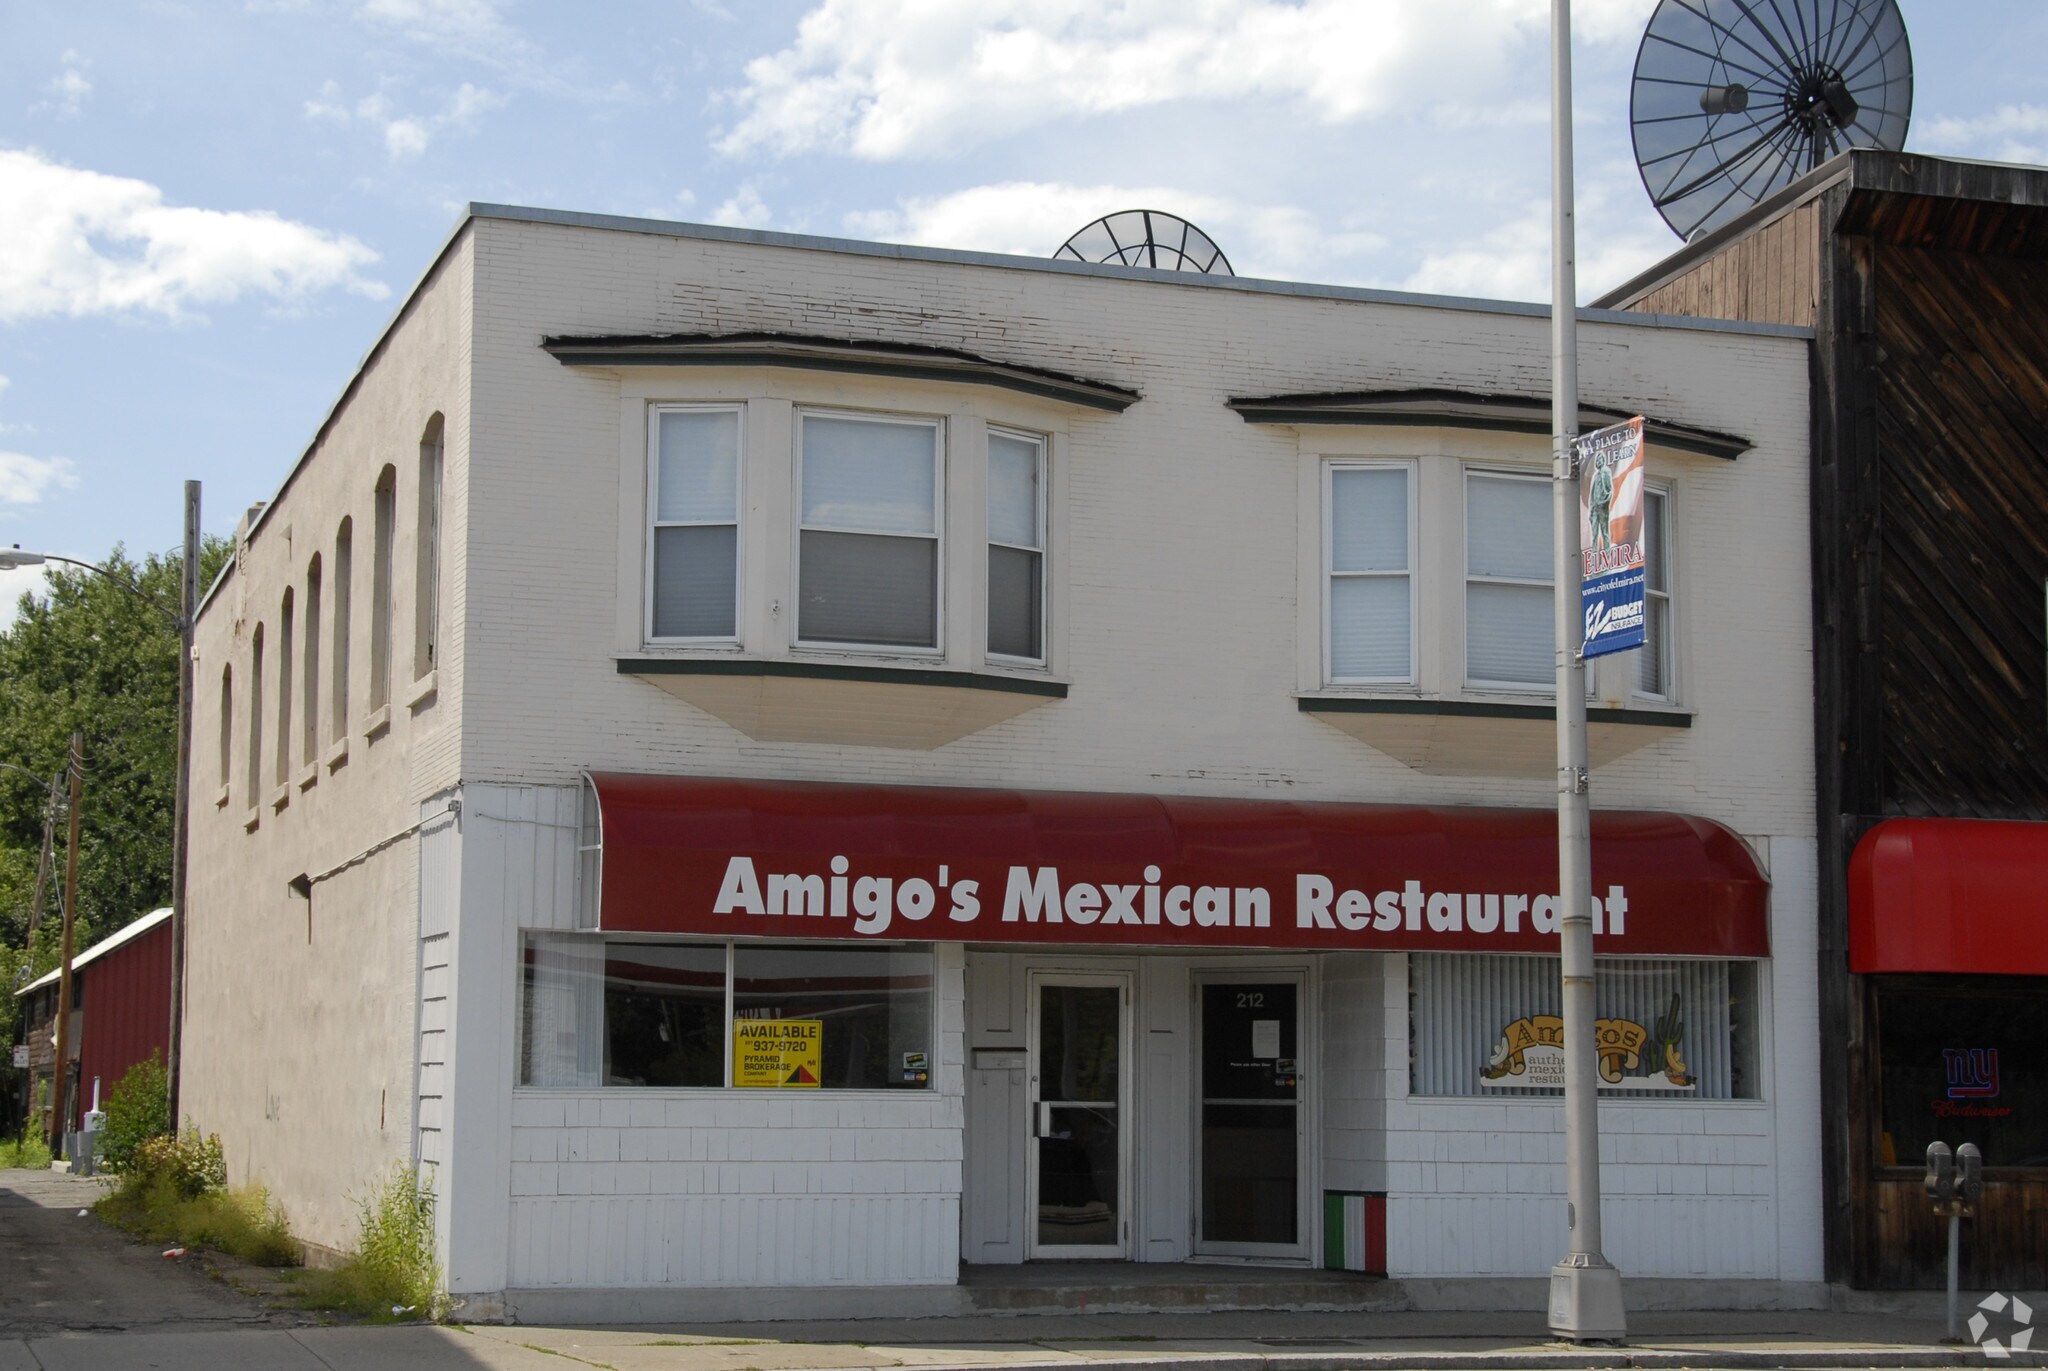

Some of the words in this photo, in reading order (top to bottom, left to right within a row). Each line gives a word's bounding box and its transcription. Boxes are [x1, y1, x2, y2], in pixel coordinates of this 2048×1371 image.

[1595, 431, 1622, 450] PLACE
[1623, 427, 1636, 441] TO
[1607, 444, 1637, 465] LEARN
[1583, 543, 1644, 577] ELMIRA
[1611, 600, 1643, 620] BUDGET
[1610, 616, 1642, 630] INSURANCE
[712, 855, 981, 935] Amigo's
[1001, 864, 1271, 927] Mexican
[1237, 993, 1264, 1007] 212
[740, 1025, 817, 1038] AVAILABLE
[1515, 1021, 1640, 1049] Amo's
[753, 1040, 807, 1052] 937-9720
[744, 1055, 780, 1063] PYRAMID
[1528, 1053, 1565, 1065] authe
[744, 1063, 791, 1071] BROKERAGE
[1528, 1064, 1565, 1074] mexi
